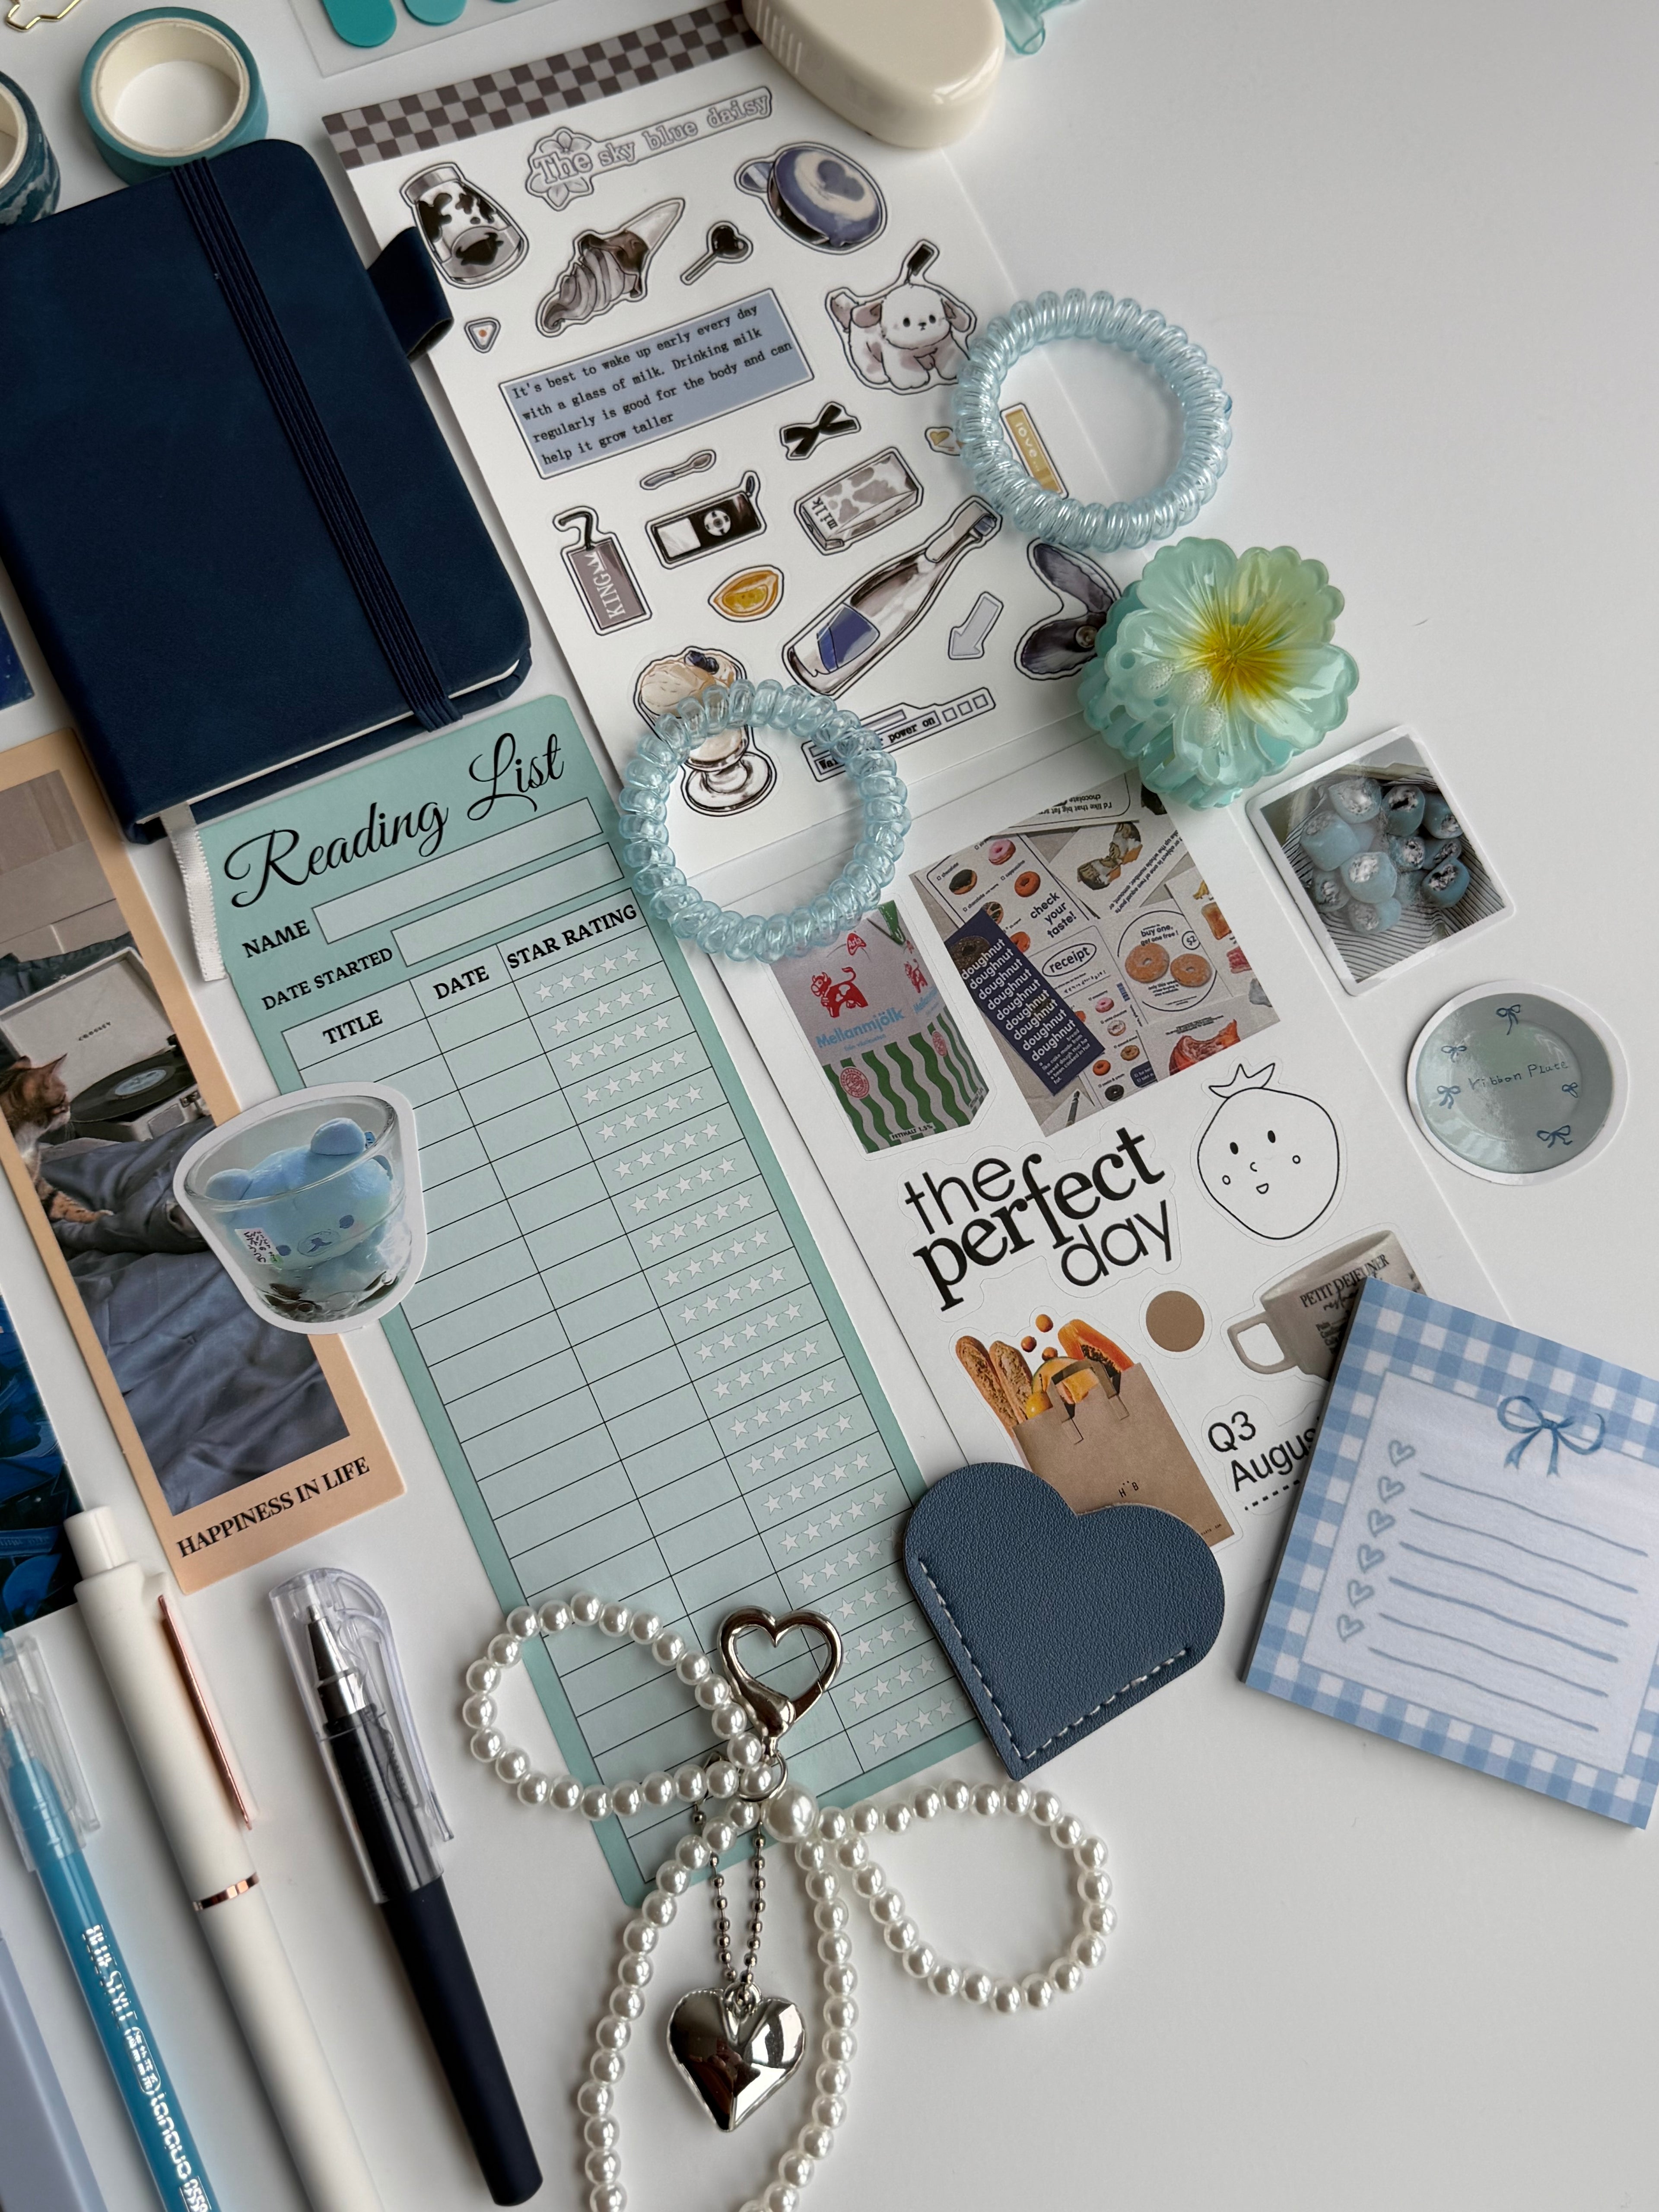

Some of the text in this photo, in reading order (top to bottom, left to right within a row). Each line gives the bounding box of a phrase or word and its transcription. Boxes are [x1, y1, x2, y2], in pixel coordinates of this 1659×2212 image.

[533, 95, 769, 184] The sky blue daisy
[512, 305, 757, 399] It's best to wake up early every day
[522, 328, 763, 421] with a glass of milk. Drinking milk
[533, 341, 792, 442] regularly is good for the body and can
[542, 412, 674, 464] help it grow taller
[812, 496, 838, 530] milk
[593, 573, 626, 619] KING
[887, 724, 919, 743] power
[922, 717, 935, 727] on
[224, 733, 565, 908] Reading List
[1030, 893, 1060, 918] check
[1044, 902, 1071, 925] your
[1047, 911, 1077, 938] taste!
[242, 920, 311, 958] NAME
[1141, 927, 1155, 937] buy
[262, 947, 393, 1011] DATE STARTED
[322, 904, 637, 1045] TITLE DATE STAR RATING
[961, 938, 1006, 980] doughnut
[970, 948, 1015, 990] doughnut
[978, 958, 1023, 1001] doughnut
[1049, 946, 1090, 972] receipt
[987, 968, 1032, 1011] doughnut
[996, 979, 1042, 1022] doughnut
[1004, 988, 1050, 1031] doughnut
[815, 1007, 906, 1049] Mellanmjölk
[1013, 998, 1058, 1041] doughnut
[1022, 1009, 1067, 1052] doughnut
[1031, 1019, 1076, 1062] doughnut
[891, 1124, 933, 1140] FETTHALT 1.5%
[905, 1158, 1016, 1234] the
[912, 1127, 1165, 1311] perfect
[1061, 1200, 1175, 1286] day
[1300, 1284, 1337, 1308] PETIT
[1208, 1411, 1256, 1452] Q3
[1230, 1427, 1318, 1492] Augus
[177, 1457, 370, 1557] HAPPINESS IN LIFE
